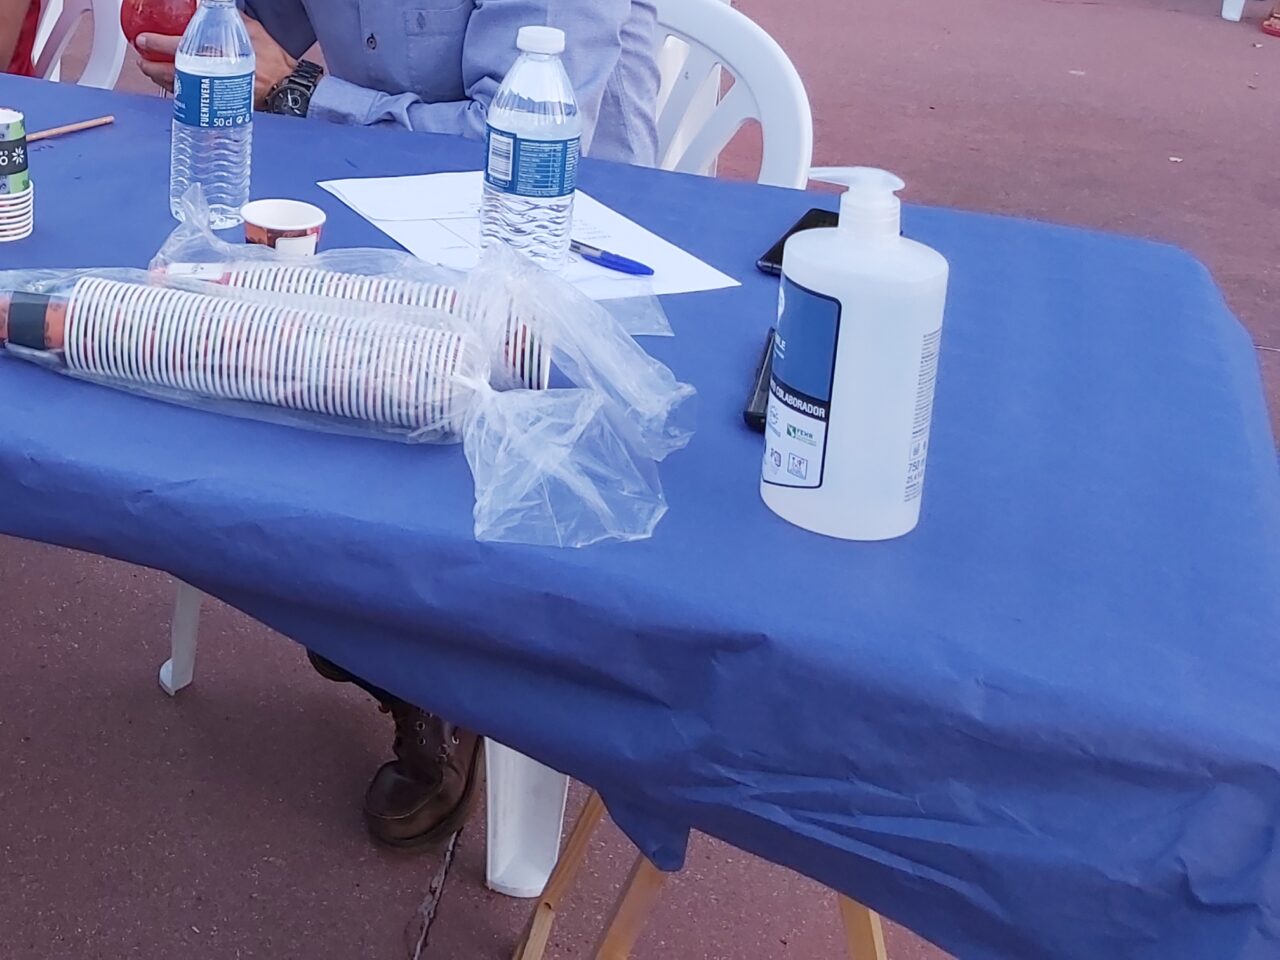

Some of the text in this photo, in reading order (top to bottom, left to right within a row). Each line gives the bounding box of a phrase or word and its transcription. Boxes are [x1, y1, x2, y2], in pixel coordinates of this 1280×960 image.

[200, 78, 210, 127] FUENTEVERA
[213, 117, 224, 127] 50
[775, 386, 826, 418] COLABORADOR
